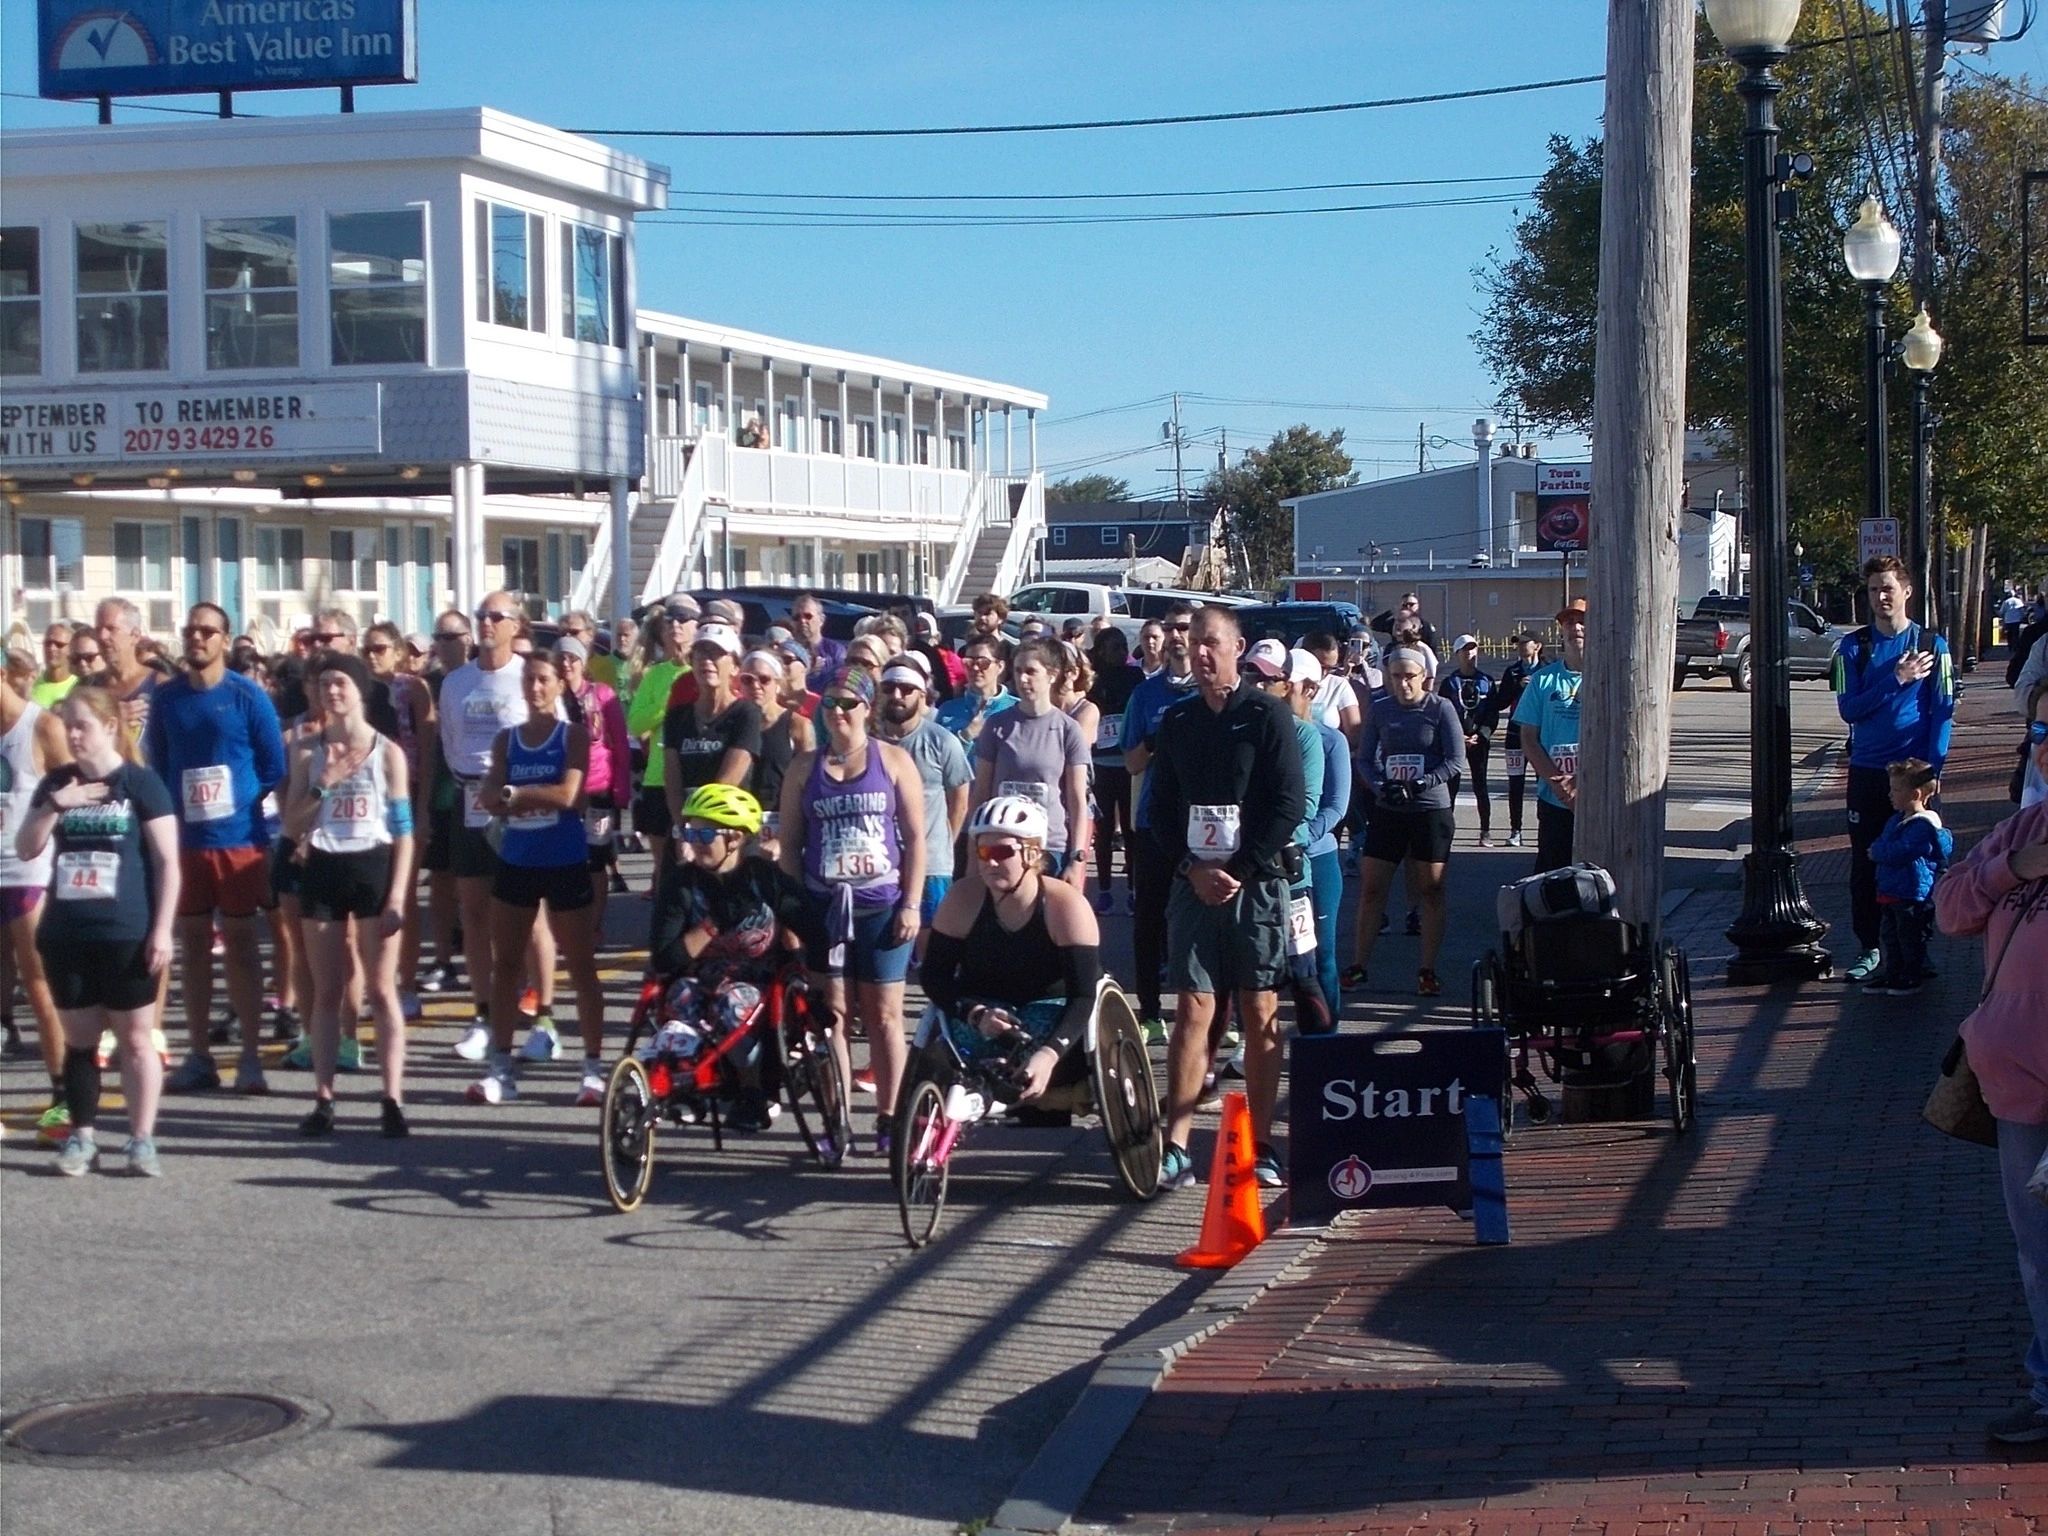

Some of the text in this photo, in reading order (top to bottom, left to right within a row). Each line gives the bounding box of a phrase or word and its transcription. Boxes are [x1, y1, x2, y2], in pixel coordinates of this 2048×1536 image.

[200, 0, 356, 26] Americas
[169, 26, 392, 65] Best Value Inn
[135, 402, 163, 424] TO
[68, 430, 97, 453] US
[1548, 469, 1582, 478] Tom's
[1540, 480, 1591, 491] Parking
[1863, 534, 1894, 545] PARKING
[511, 763, 557, 778] Dirigo
[1391, 766, 1418, 782] 202
[1555, 756, 1578, 774] 20
[188, 782, 222, 804] 207
[331, 796, 368, 818] 203
[813, 791, 887, 818] SWEARING
[1204, 823, 1218, 846] 2
[835, 853, 875, 876] 136
[71, 868, 98, 888] 44
[1322, 1077, 1466, 1121] Start
[1223, 1131, 1238, 1208] RACE
